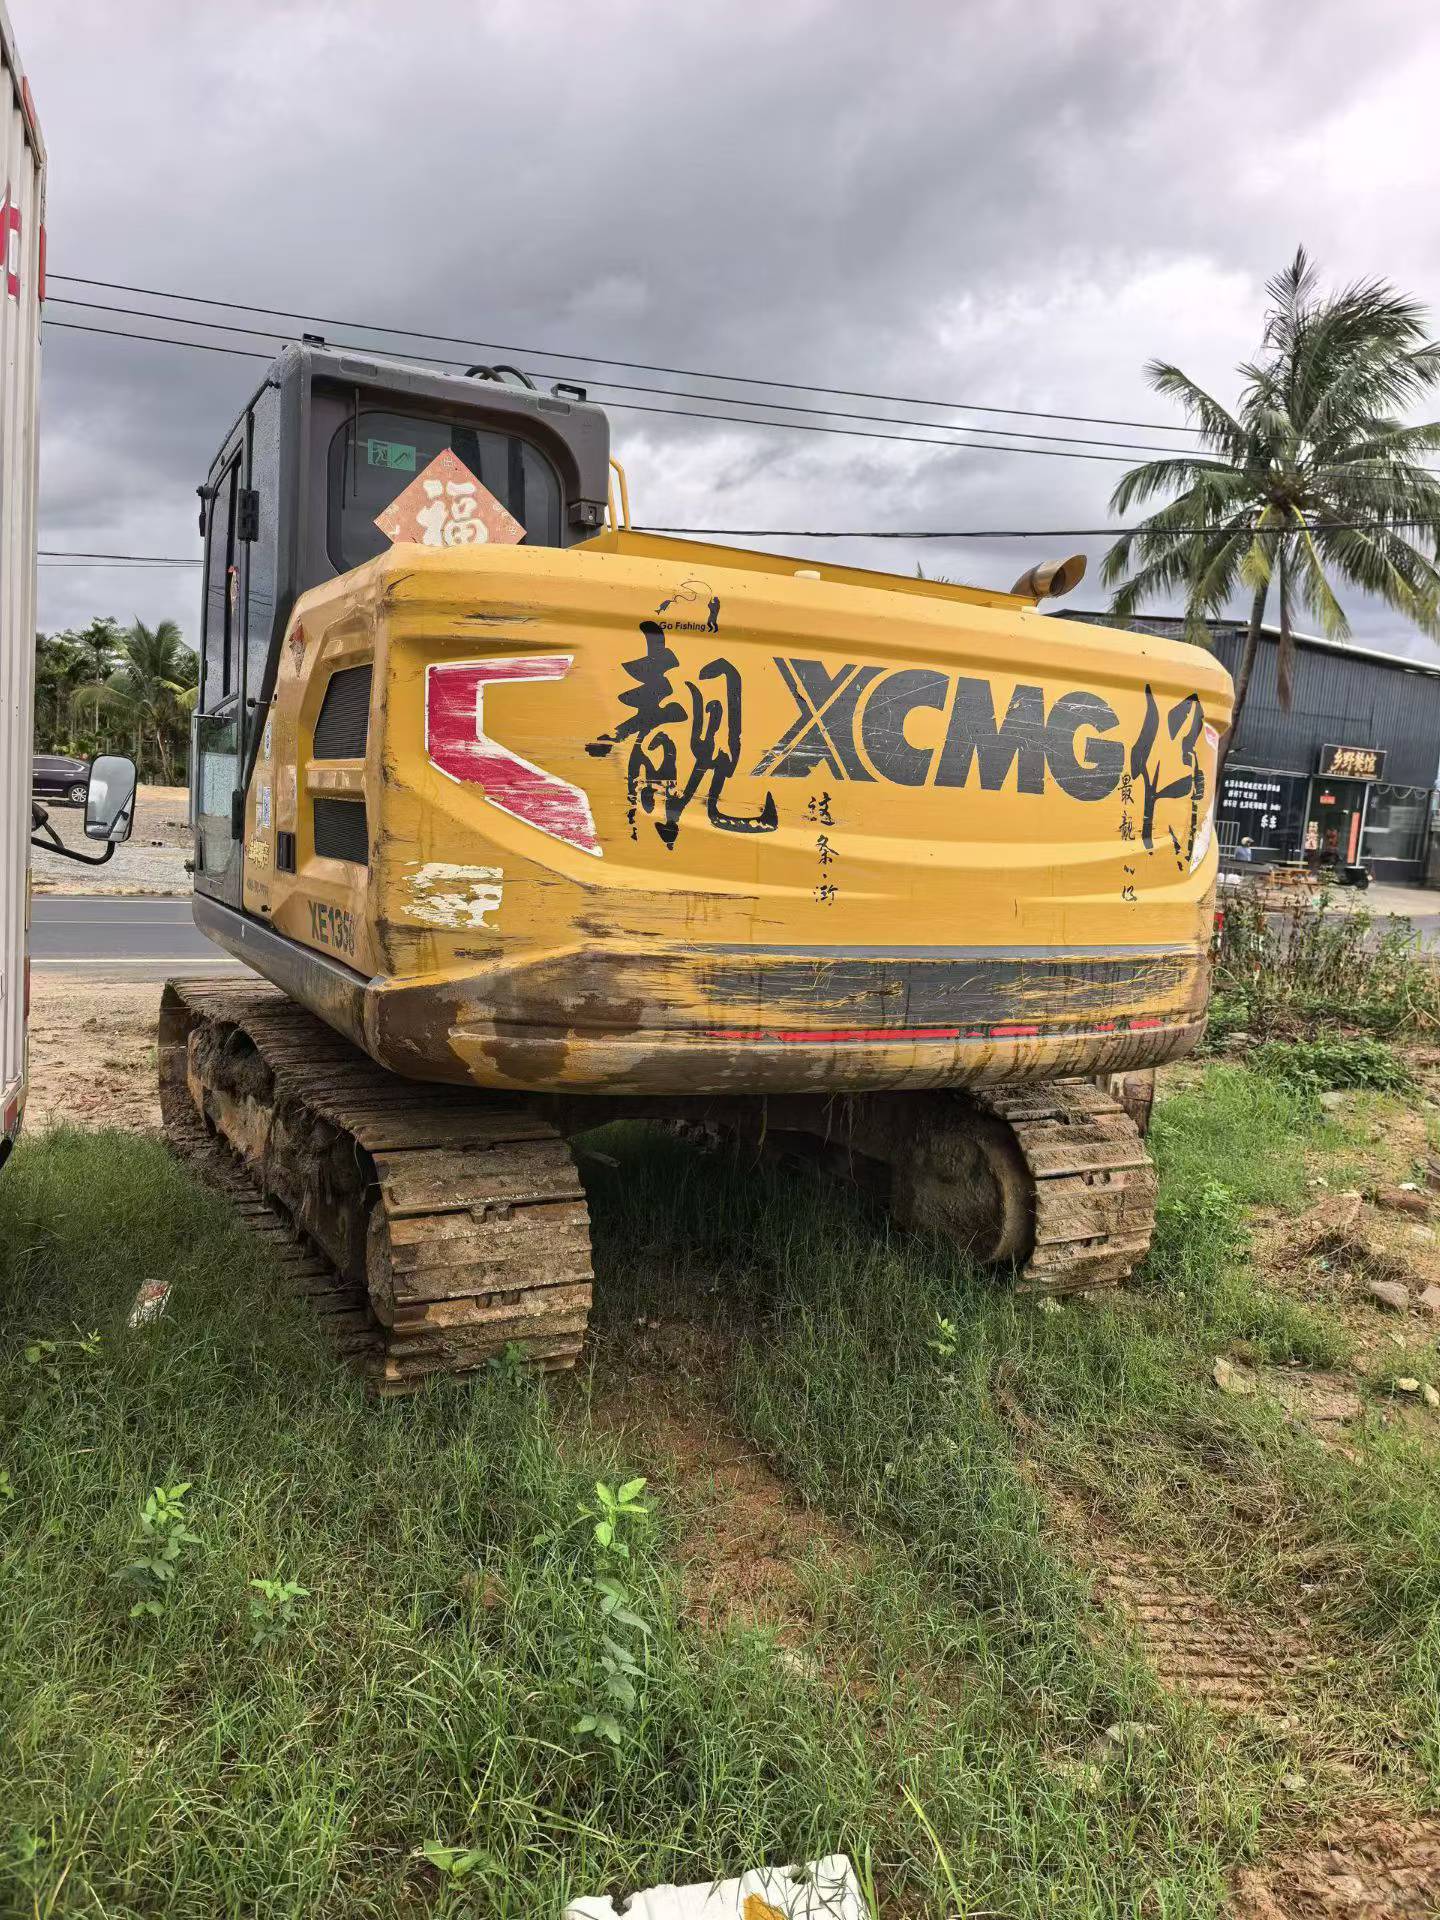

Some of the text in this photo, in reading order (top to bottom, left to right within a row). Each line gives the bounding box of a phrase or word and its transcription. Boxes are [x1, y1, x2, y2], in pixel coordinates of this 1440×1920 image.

[660, 621, 706, 633] Go Fishing
[750, 656, 1124, 802] XCMG
